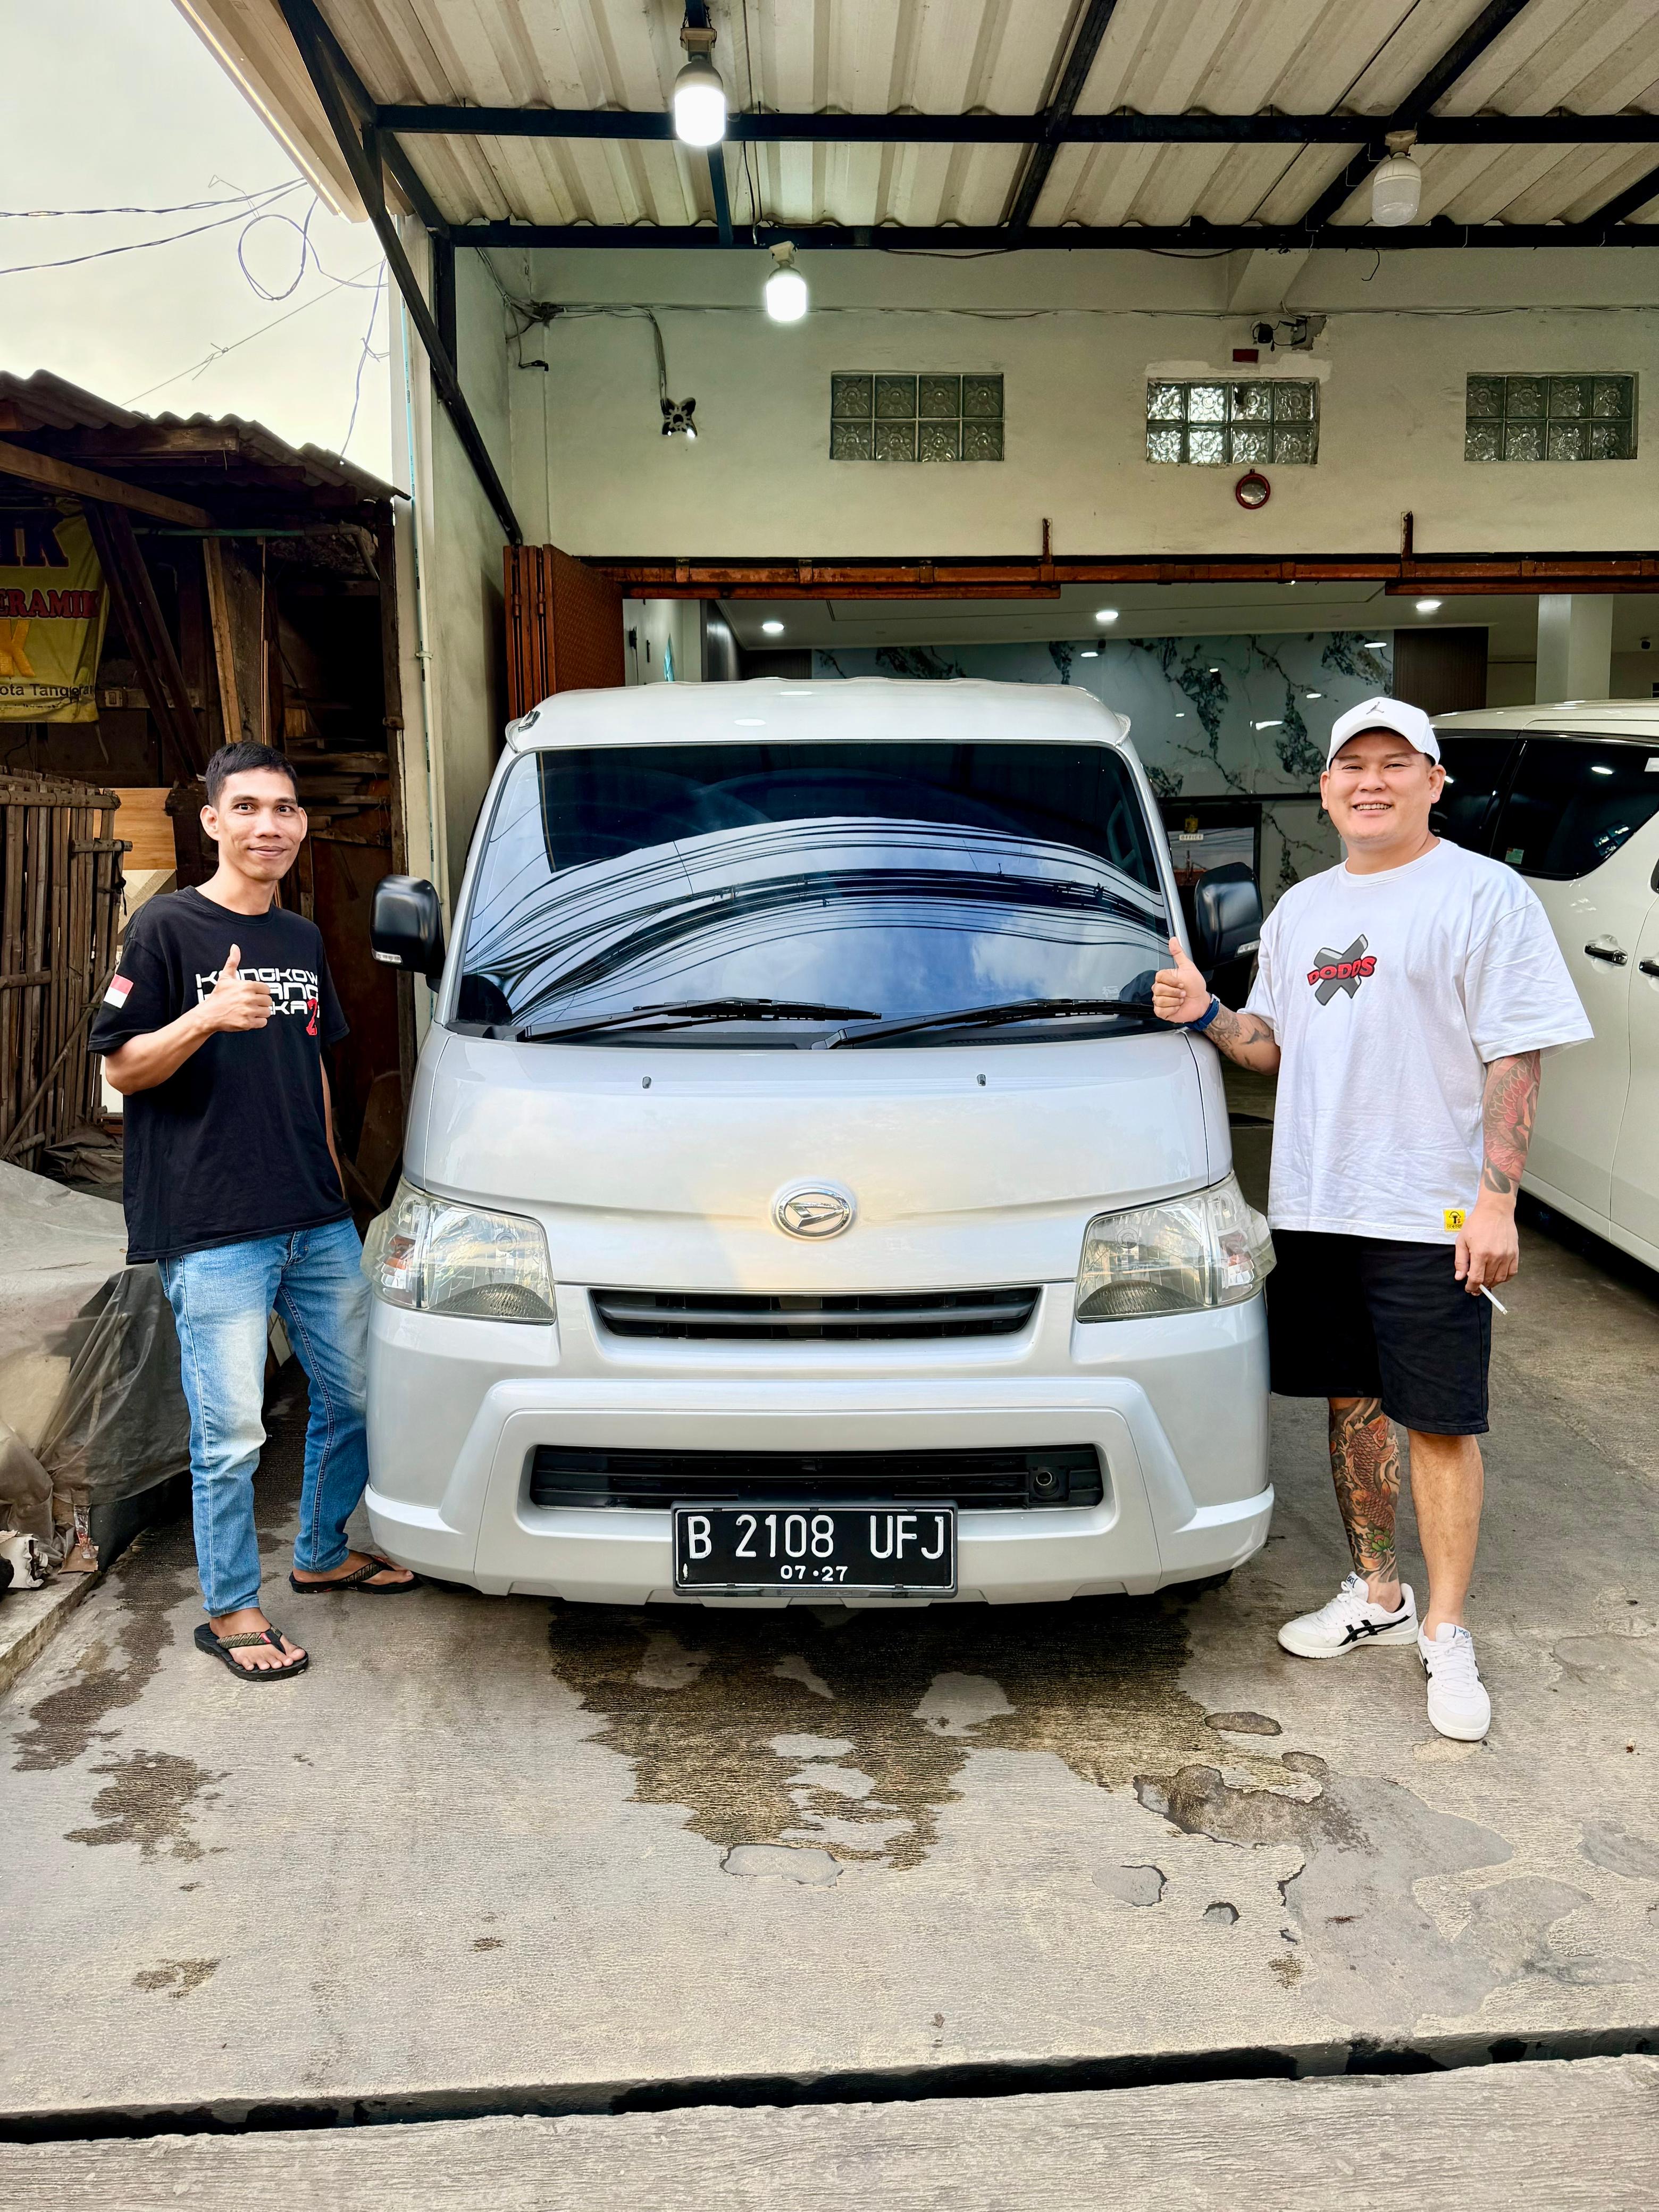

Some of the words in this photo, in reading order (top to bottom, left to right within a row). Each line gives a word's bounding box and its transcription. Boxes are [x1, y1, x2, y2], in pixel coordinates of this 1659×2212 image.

[688, 1516, 712, 1559] B
[736, 1514, 834, 1559] 2108
[870, 1515, 944, 1559] UFJ
